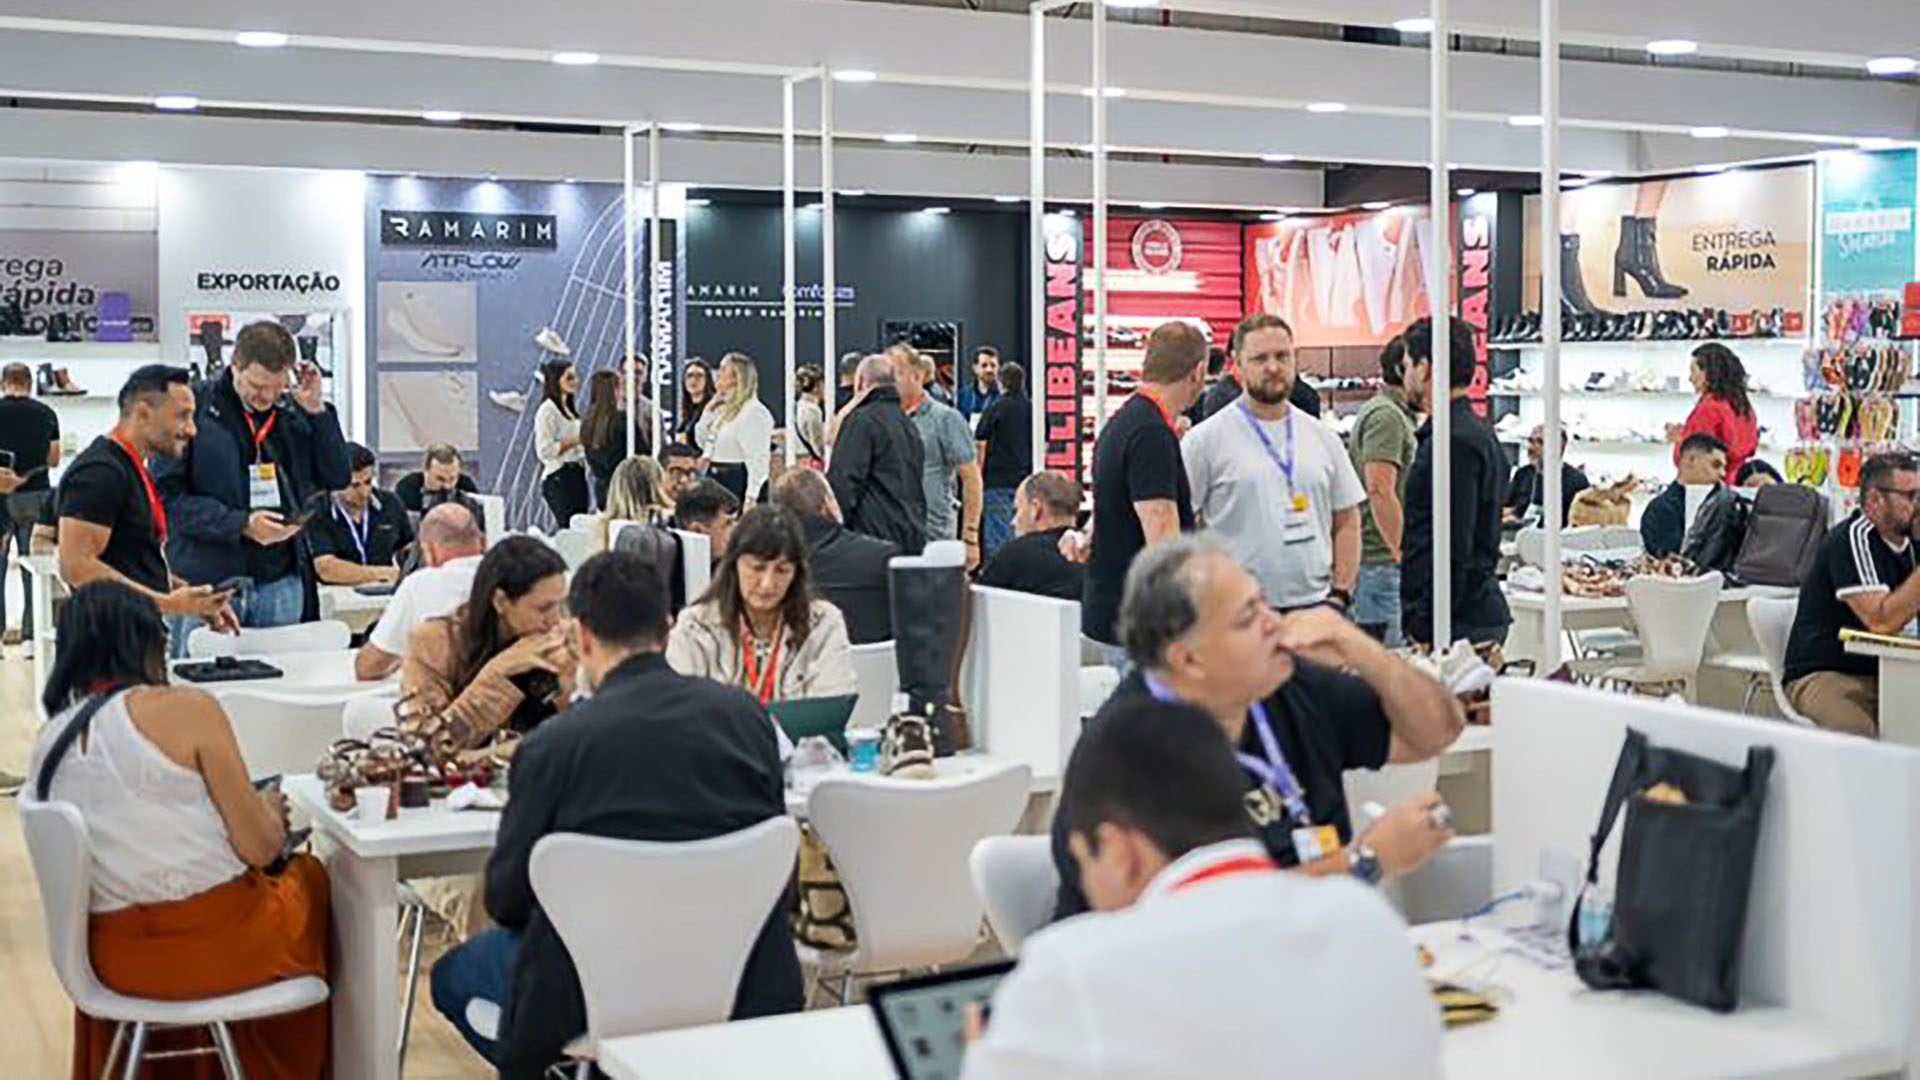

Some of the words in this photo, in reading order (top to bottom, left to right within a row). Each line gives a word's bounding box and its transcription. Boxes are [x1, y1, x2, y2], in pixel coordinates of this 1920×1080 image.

[389, 217, 552, 240] RAMARIM
[1692, 231, 1776, 251] ENTREGA
[0, 259, 63, 283] ega
[1706, 250, 1776, 271] RÁPIDA
[0, 278, 95, 308] ápida
[197, 271, 340, 293] EXPORTAÇÃO
